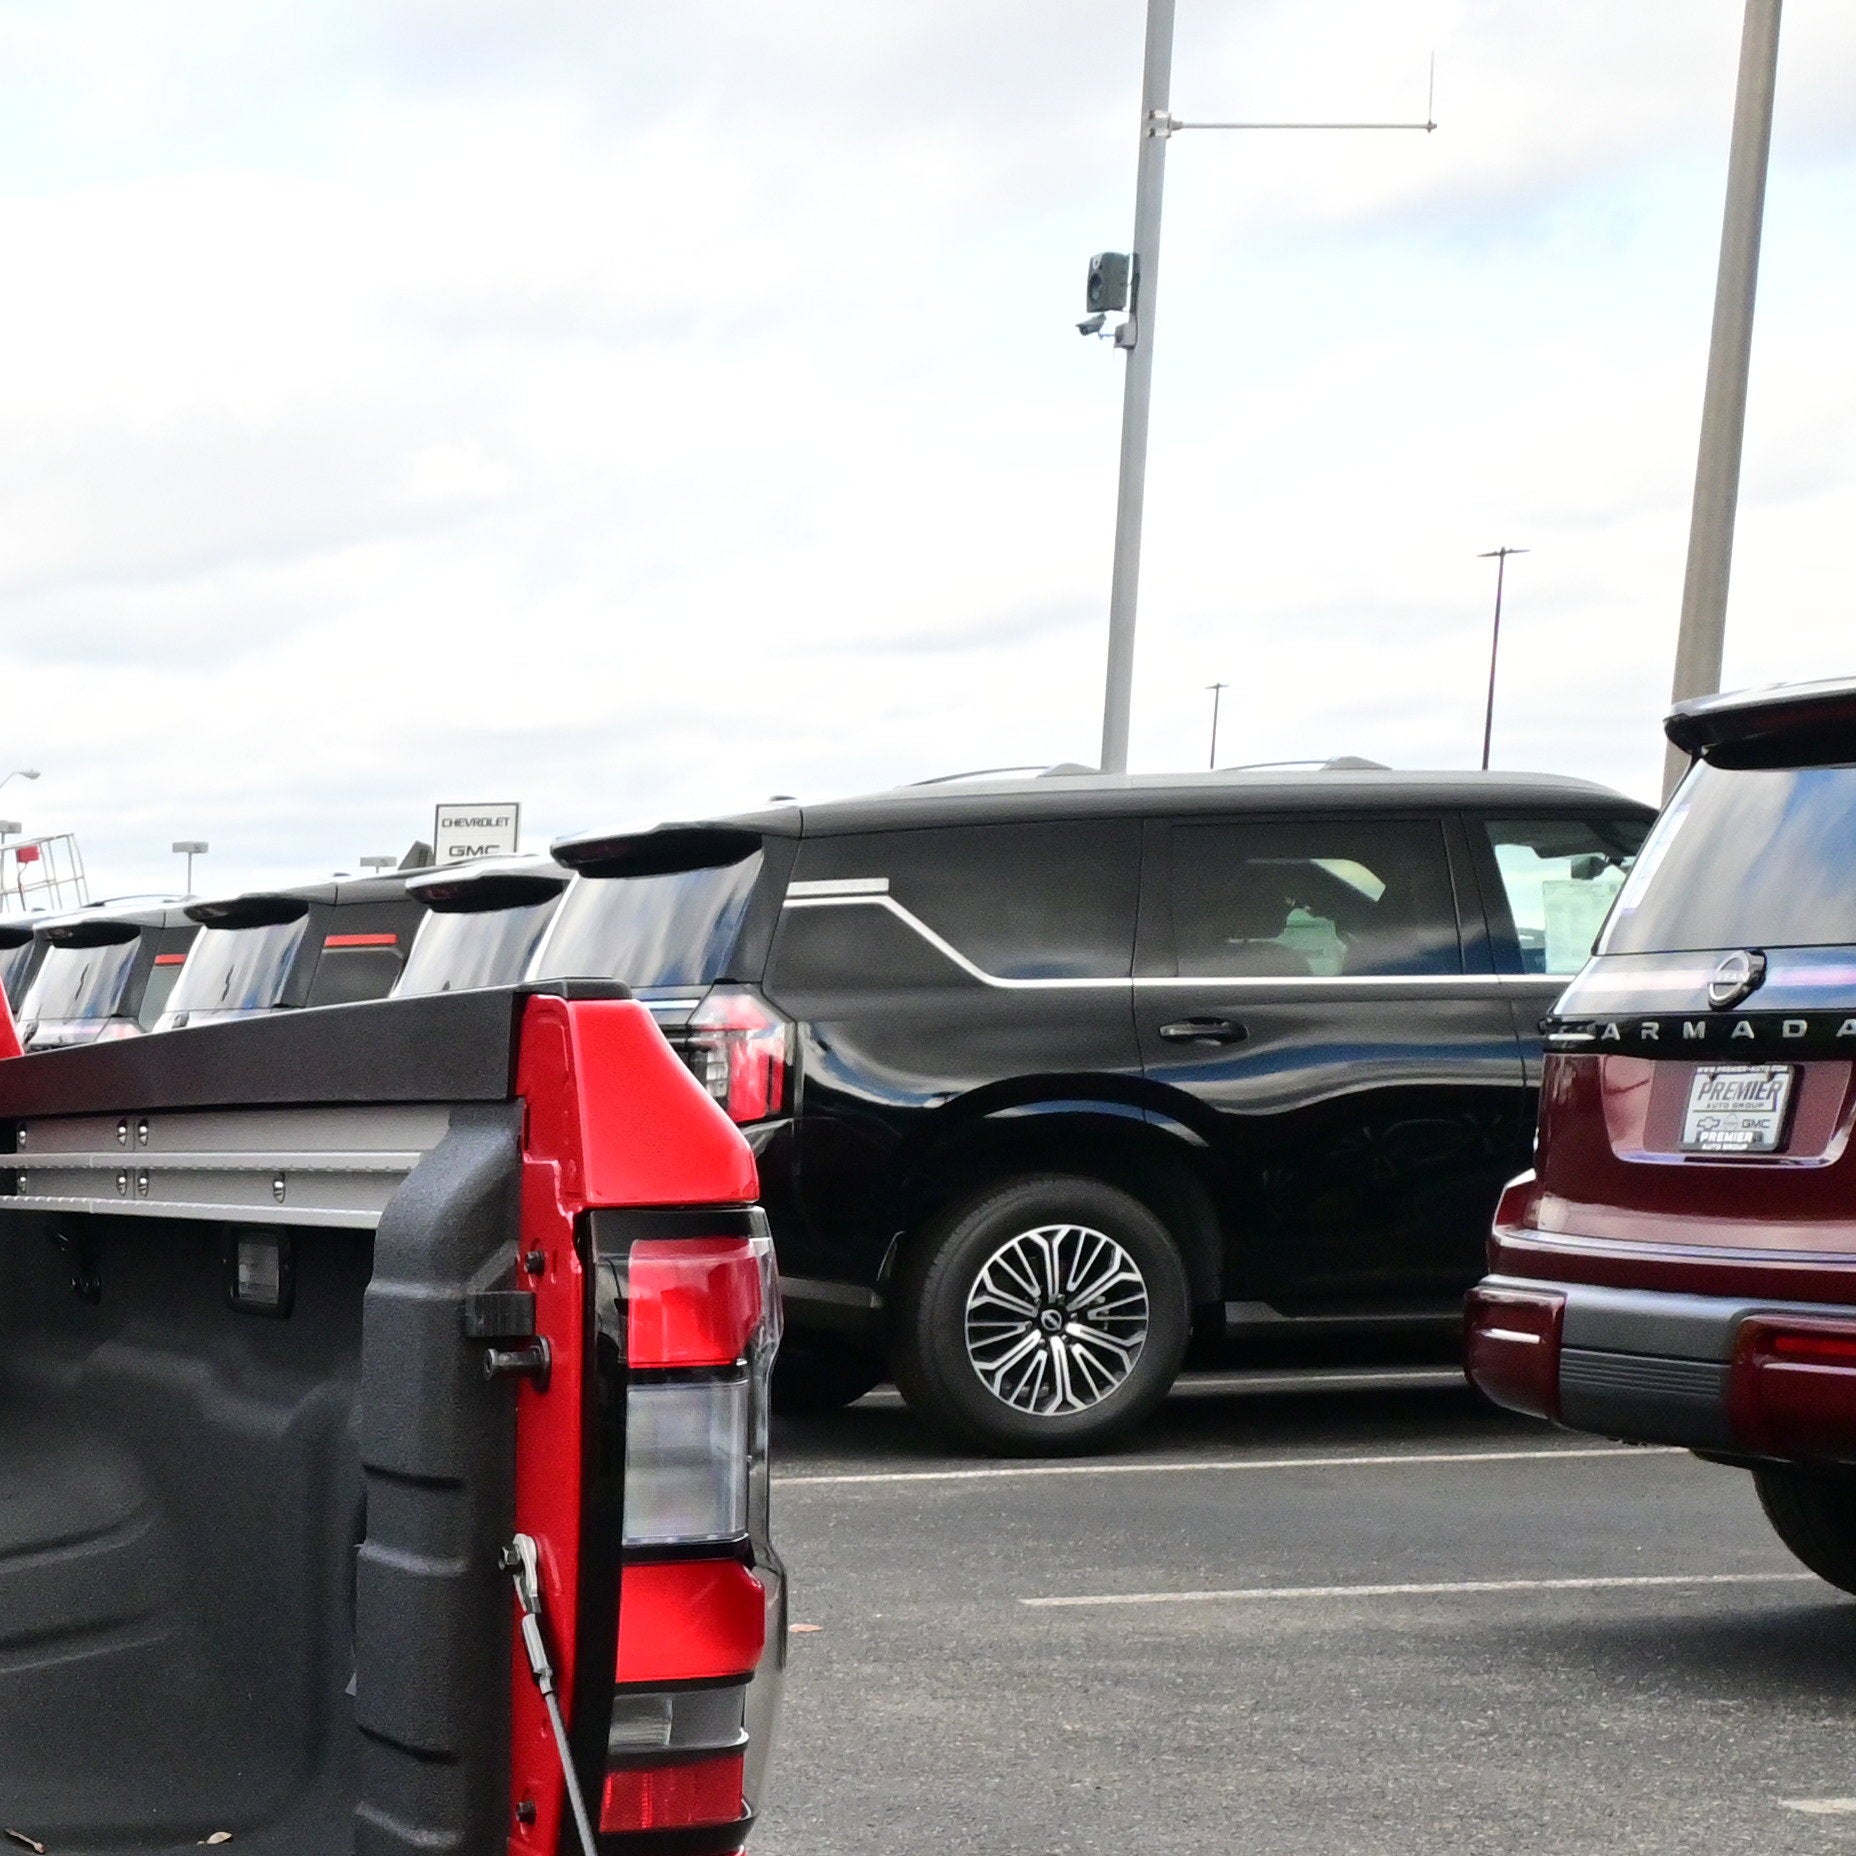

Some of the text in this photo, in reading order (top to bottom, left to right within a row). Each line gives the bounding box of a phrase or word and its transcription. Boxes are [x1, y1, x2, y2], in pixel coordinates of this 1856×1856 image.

[441, 816, 510, 828] CHEVROLET
[449, 844, 500, 857] GMC
[1600, 1018, 1856, 1041] ARMADA
[1698, 1081, 1783, 1101] PREMIER
[1741, 1119, 1771, 1129] GMC
[1699, 1131, 1754, 1143] PREMIER
